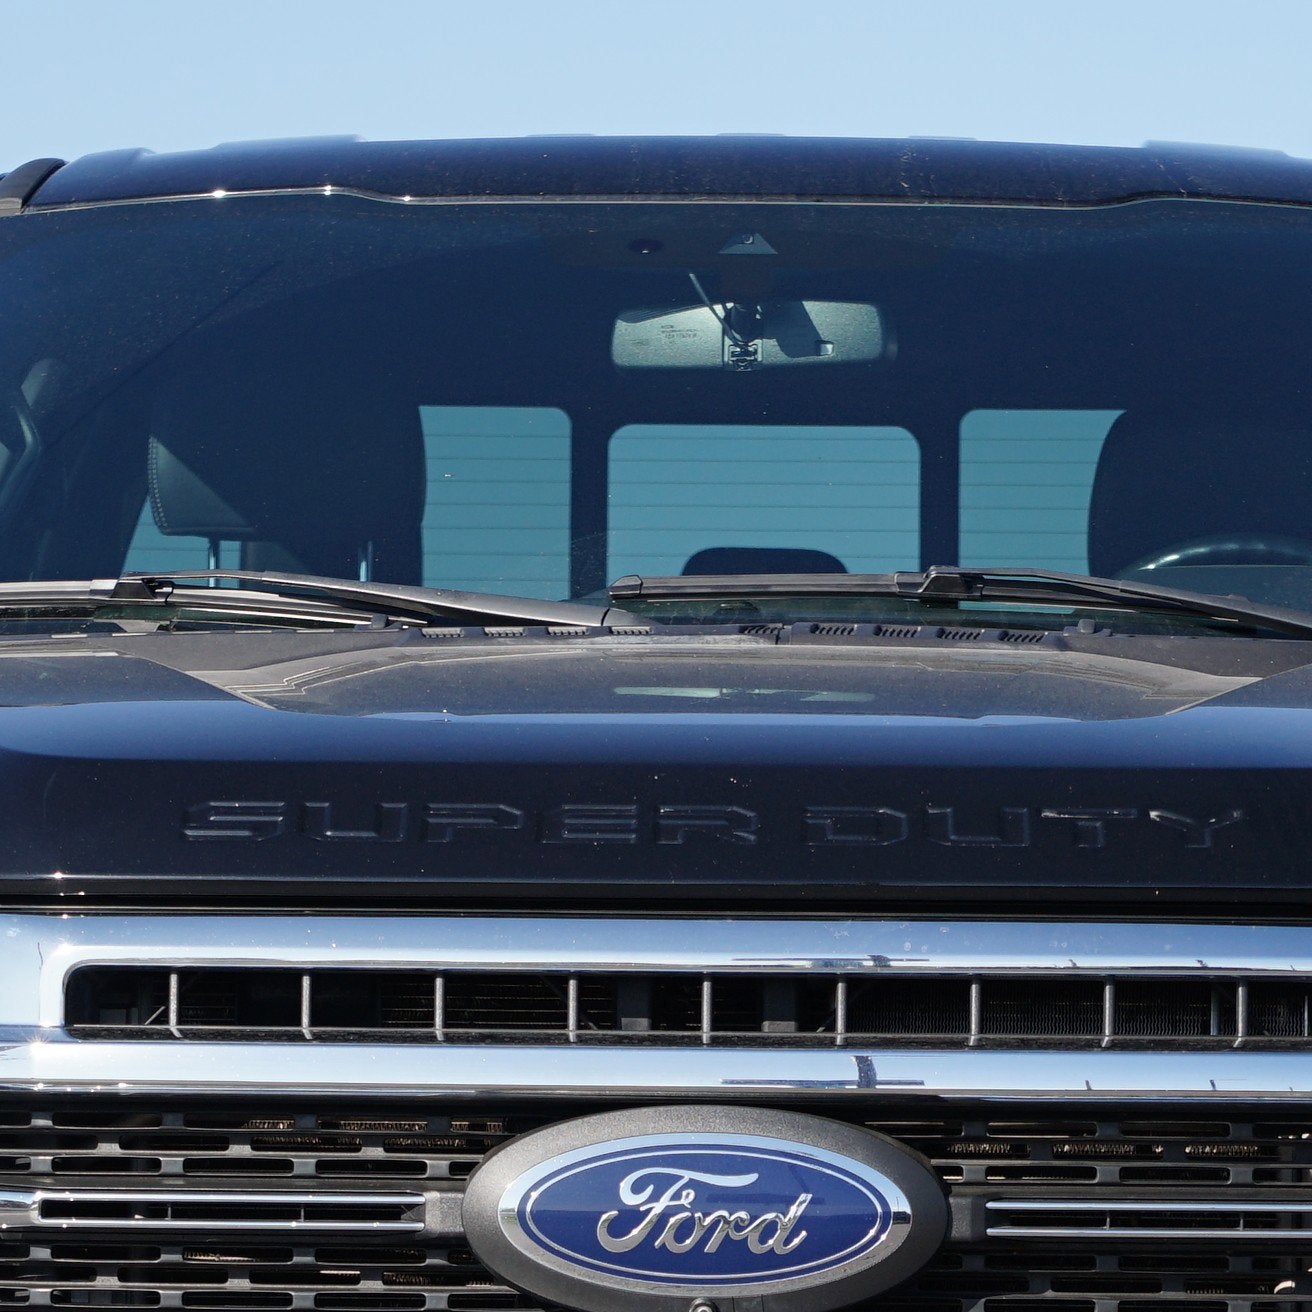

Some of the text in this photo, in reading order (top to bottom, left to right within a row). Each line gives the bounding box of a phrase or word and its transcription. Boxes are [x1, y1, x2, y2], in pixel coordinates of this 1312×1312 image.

[183, 801, 1243, 848] SUPER DUTY
[596, 1166, 813, 1254] Ford
